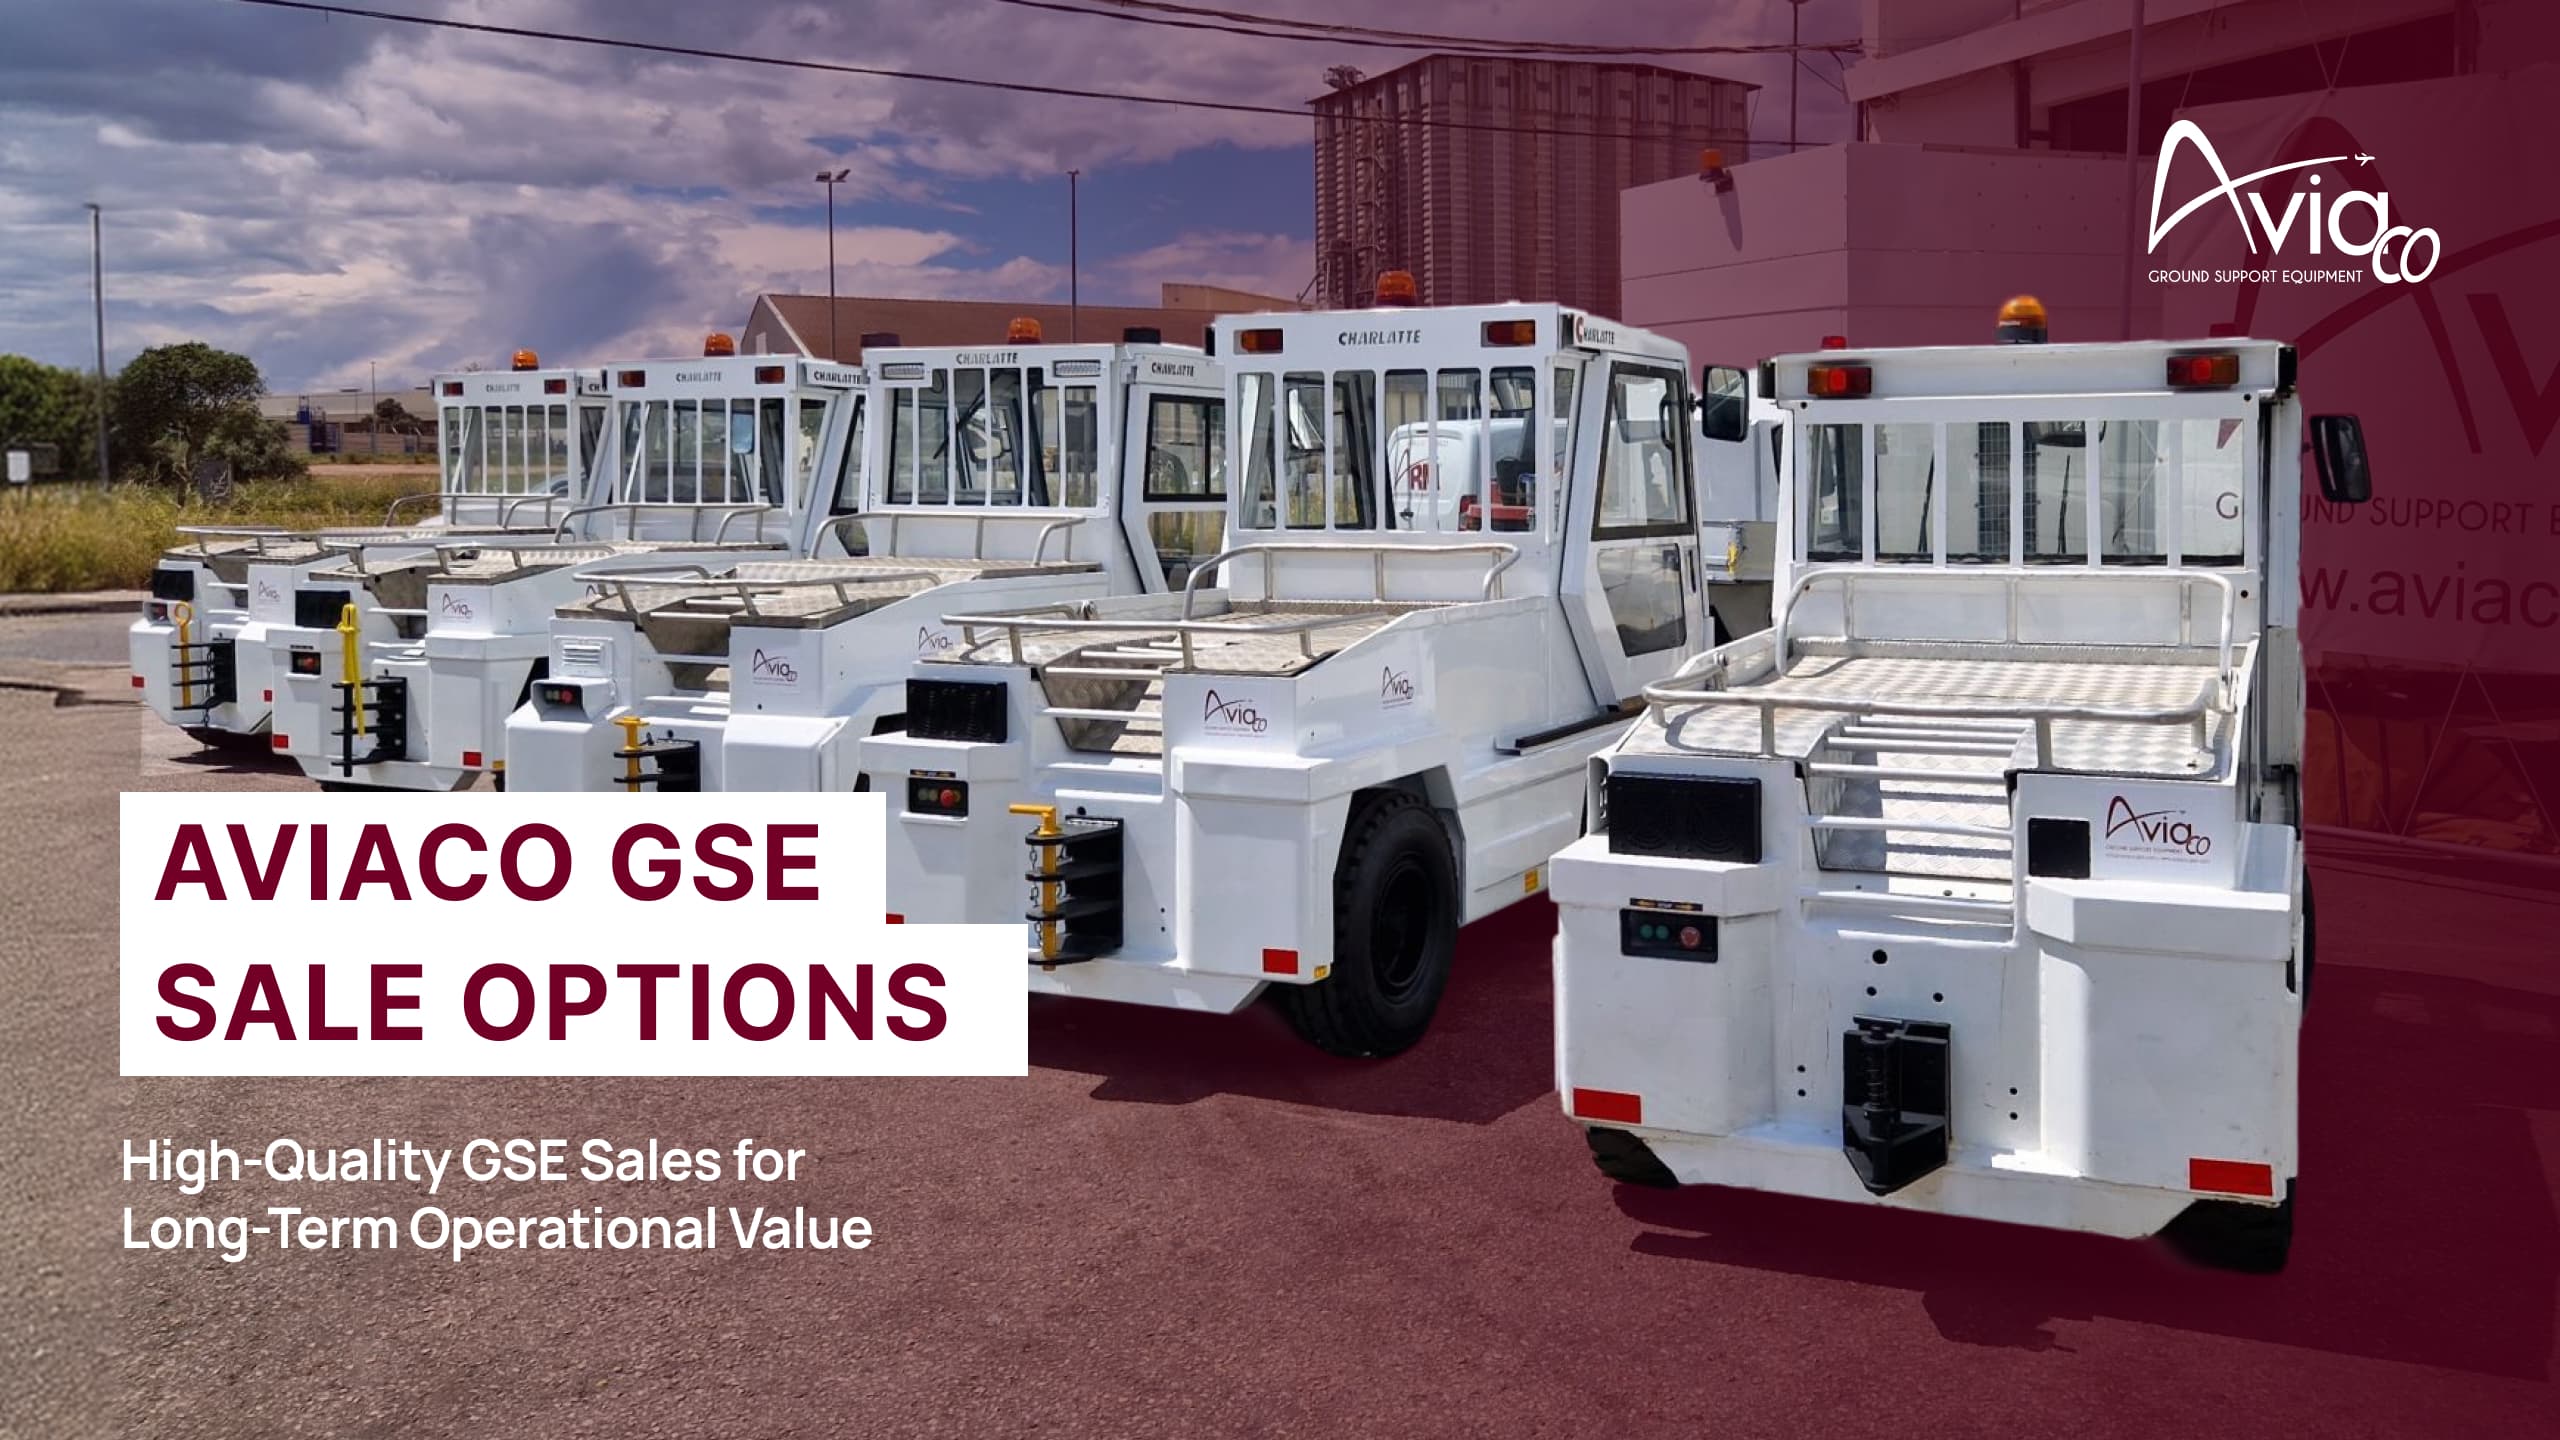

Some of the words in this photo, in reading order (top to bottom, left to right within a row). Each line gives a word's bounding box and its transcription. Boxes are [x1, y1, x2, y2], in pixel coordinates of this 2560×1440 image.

[1338, 329, 1421, 346] CHARLATTE
[956, 352, 1018, 364] CHARLATTE
[2370, 496, 2534, 534] SUPPORT
[2105, 795, 2211, 855] Aviaco
